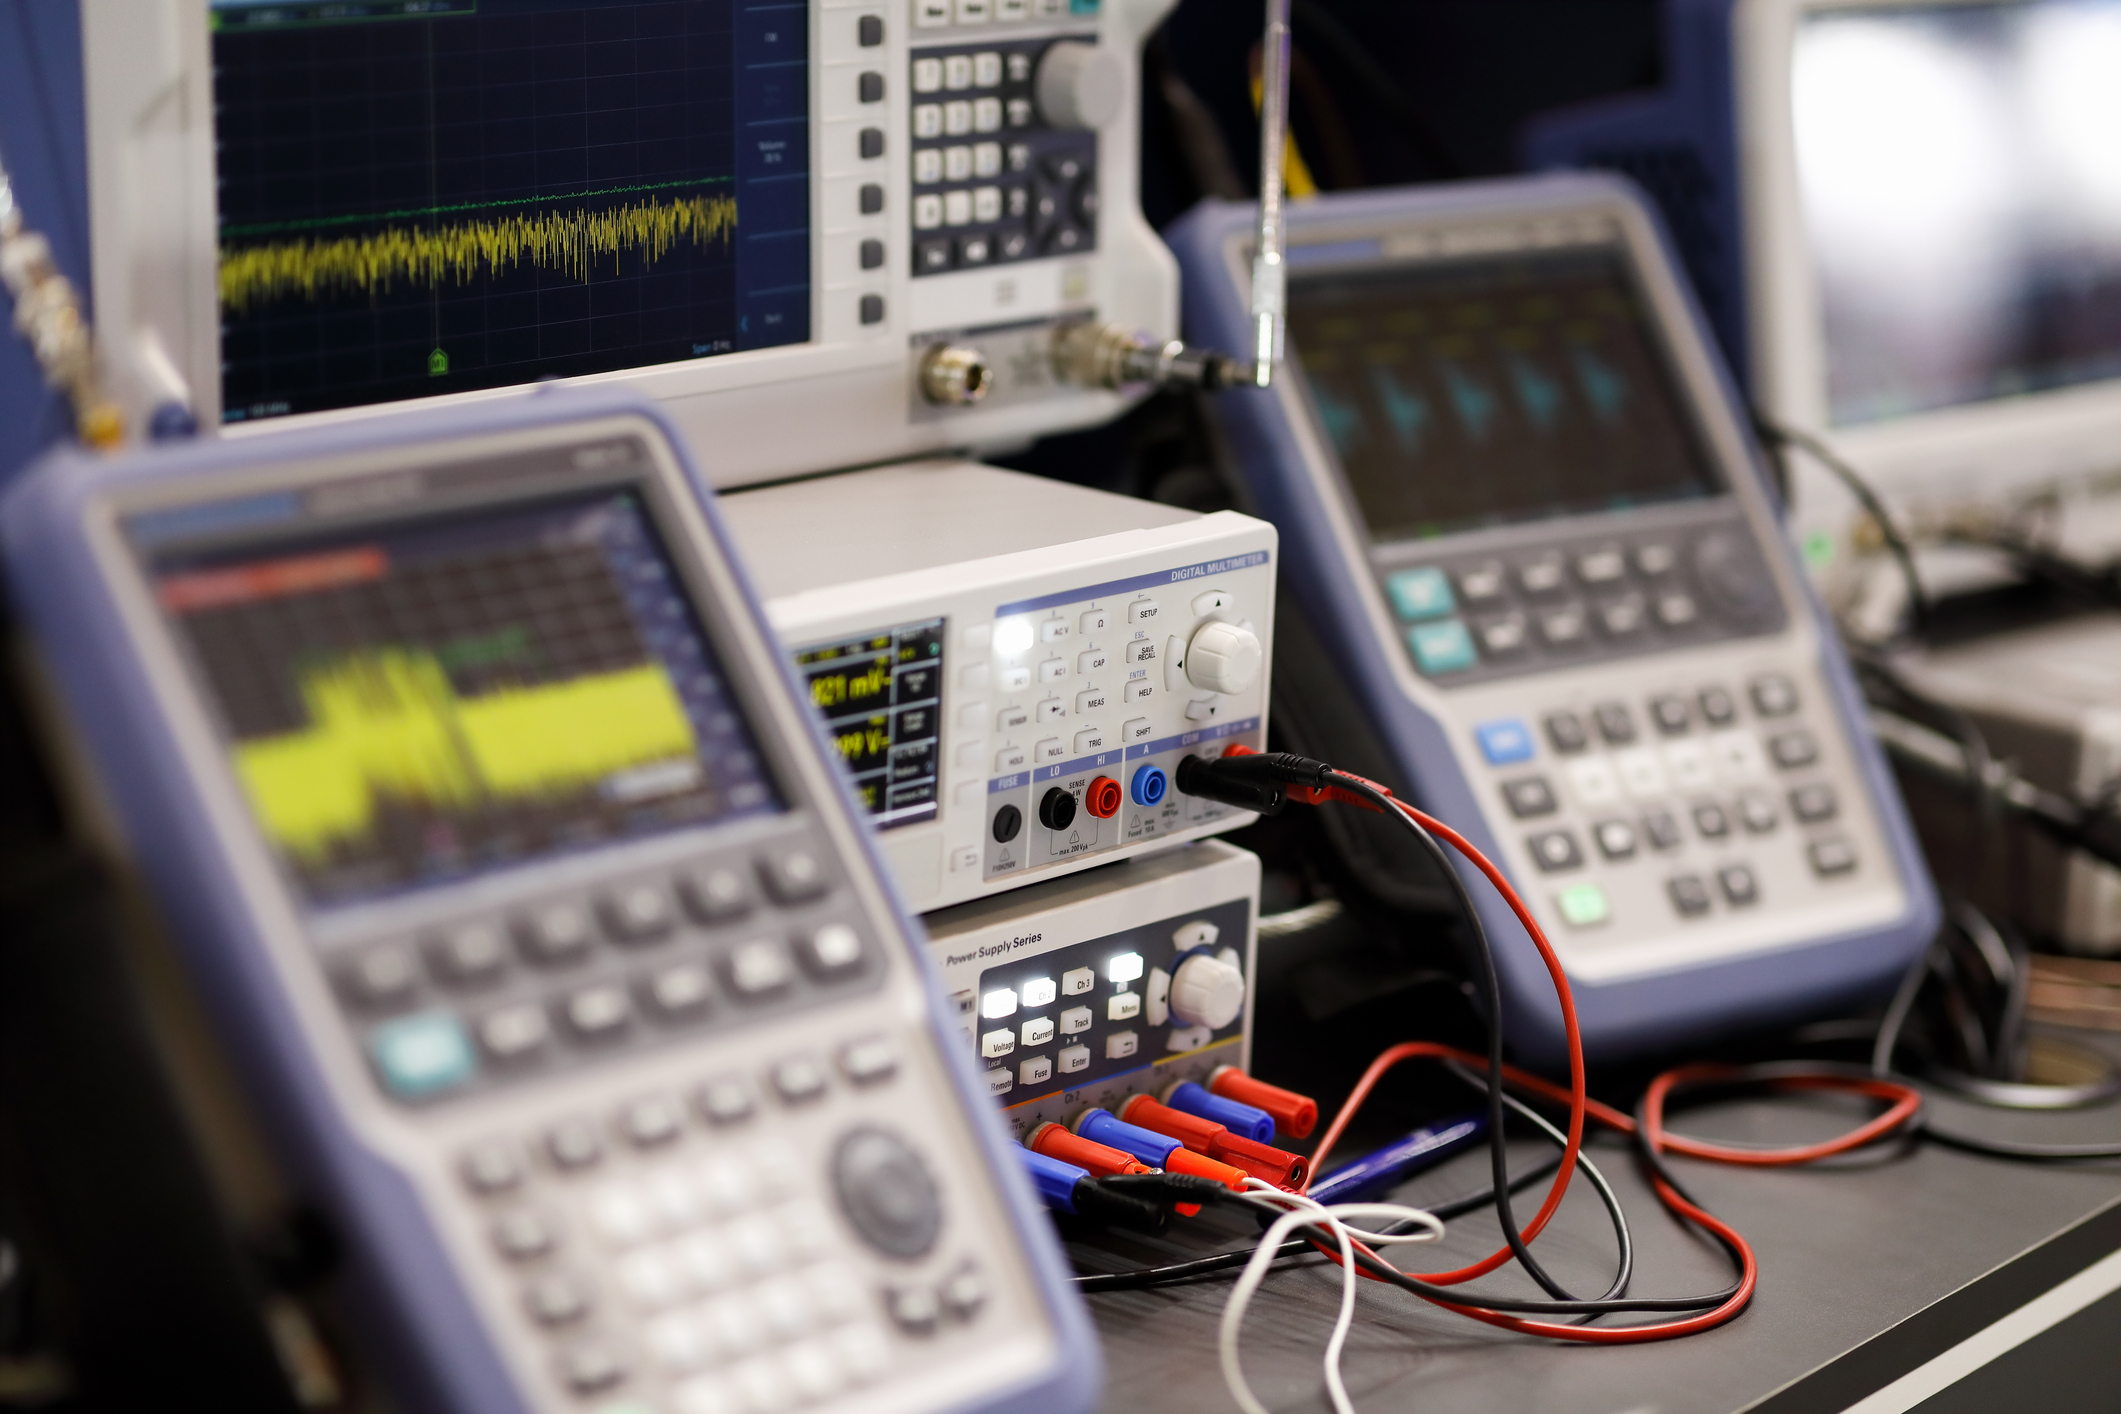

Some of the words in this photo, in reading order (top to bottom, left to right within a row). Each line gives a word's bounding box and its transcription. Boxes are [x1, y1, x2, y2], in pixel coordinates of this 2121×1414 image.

[431, 357, 444, 369] M1
[1171, 564, 1206, 581] DIGITAL
[1207, 552, 1264, 574] MULTIMETER
[1140, 608, 1158, 618] SETUP
[1053, 627, 1063, 636] AC
[1064, 625, 1070, 634] V
[1134, 631, 1145, 639] ESC
[1141, 645, 1154, 654] SAVE
[1137, 651, 1156, 661] RECALL
[1093, 658, 1105, 668] CAP
[1054, 668, 1062, 676] AC
[1129, 669, 1146, 680] ENTER
[1138, 687, 1153, 697] HELP
[1087, 697, 1105, 708] MEAS
[1135, 726, 1151, 737] SHIFT
[1088, 738, 1102, 748] TRIG
[1182, 732, 1200, 746] COM
[1048, 747, 1064, 757] NULL
[1143, 744, 1149, 754] A
[1008, 756, 1024, 766] HOLD
[1097, 754, 1106, 766] HI
[1050, 765, 1060, 777] LO
[998, 775, 1018, 790] FUSE
[1069, 779, 1086, 789] SENSE
[1128, 827, 1142, 838] Fused
[1070, 844, 1079, 853] 200
[1080, 842, 1089, 852] Vpk
[947, 951, 977, 967] Power
[978, 940, 1012, 958] Supply
[1013, 933, 1042, 949] Series
[1077, 980, 1085, 990] Ch
[1086, 978, 1090, 988] 3
[1121, 1004, 1137, 1014] Menu
[1075, 1018, 1089, 1028] Track
[1032, 1029, 1053, 1041] Current
[993, 1041, 1014, 1053] Voltage
[988, 1057, 1002, 1068] Local
[1072, 1058, 1087, 1067] Enter
[1034, 1069, 1048, 1079] Fuse
[990, 1080, 1012, 1092] Remote
[1064, 1092, 1074, 1104] Ch
[1075, 1090, 1080, 1101] 2
